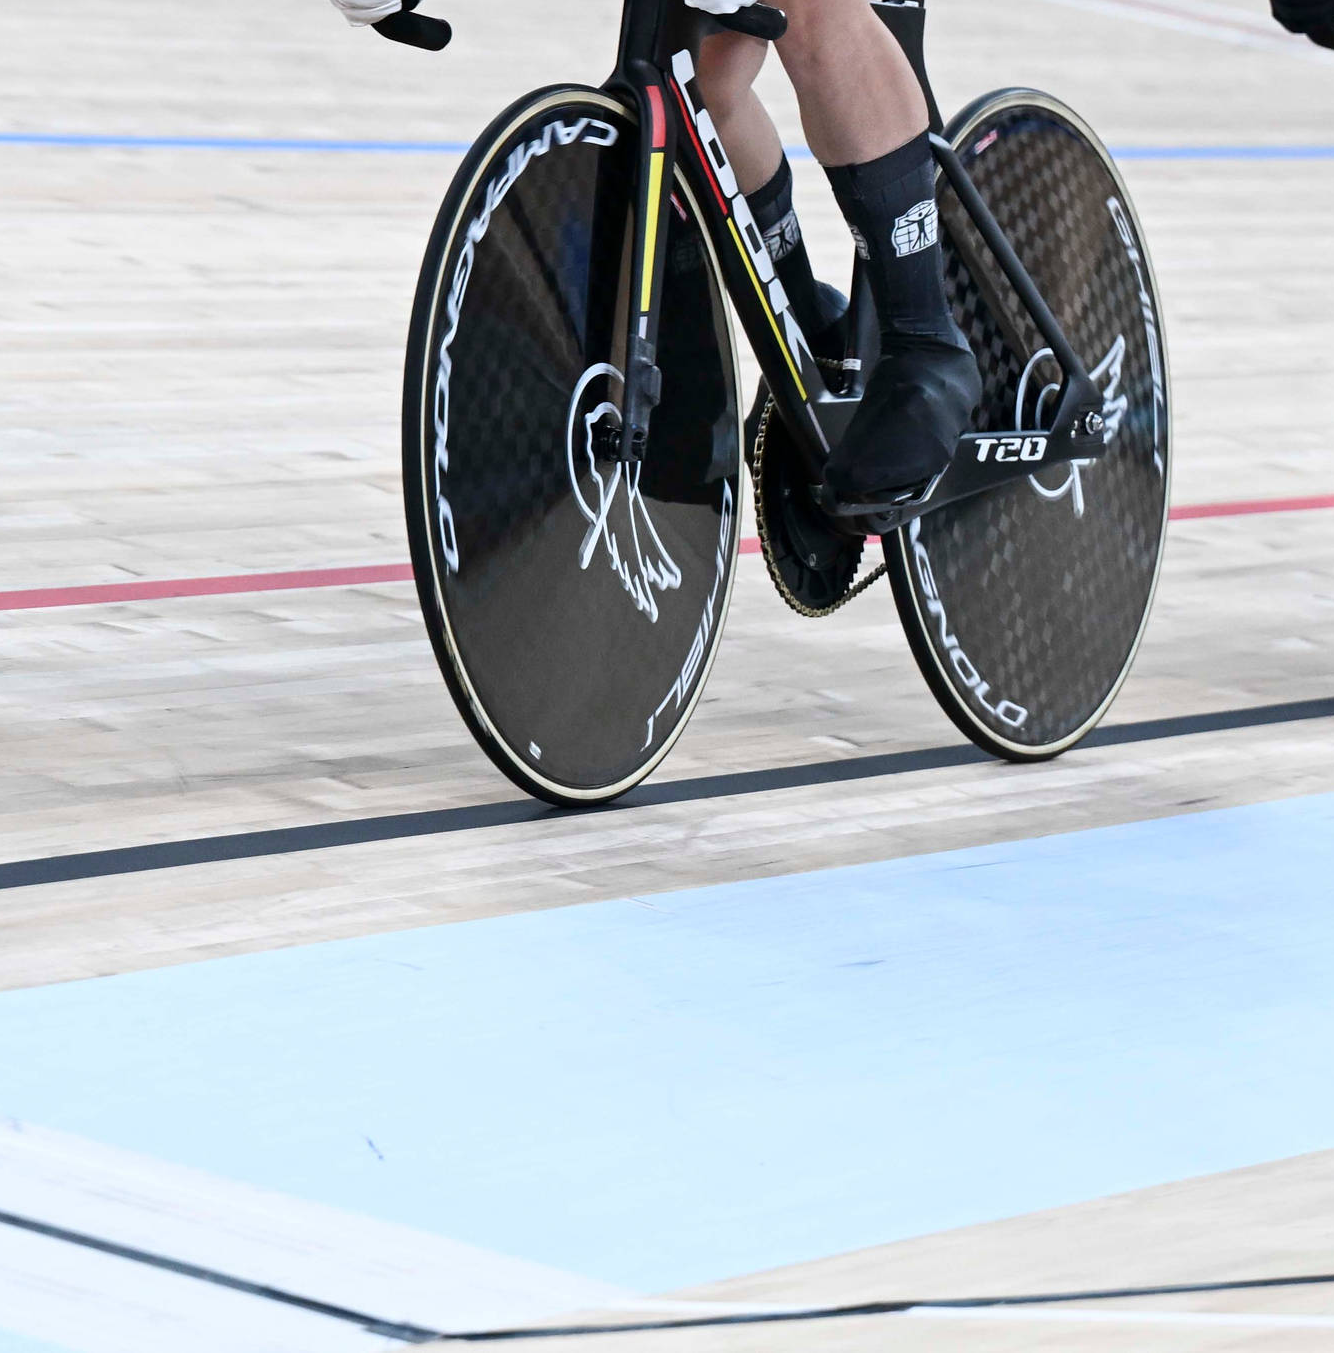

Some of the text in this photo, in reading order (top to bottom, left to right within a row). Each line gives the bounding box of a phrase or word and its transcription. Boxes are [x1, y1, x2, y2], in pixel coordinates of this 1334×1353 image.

[434, 117, 619, 577] CAMPAGNOLO
[671, 49, 814, 375] LOOK
[1107, 196, 1165, 480] GHIBLI
[975, 437, 1048, 462] T20
[640, 477, 733, 752] GHIBLI
